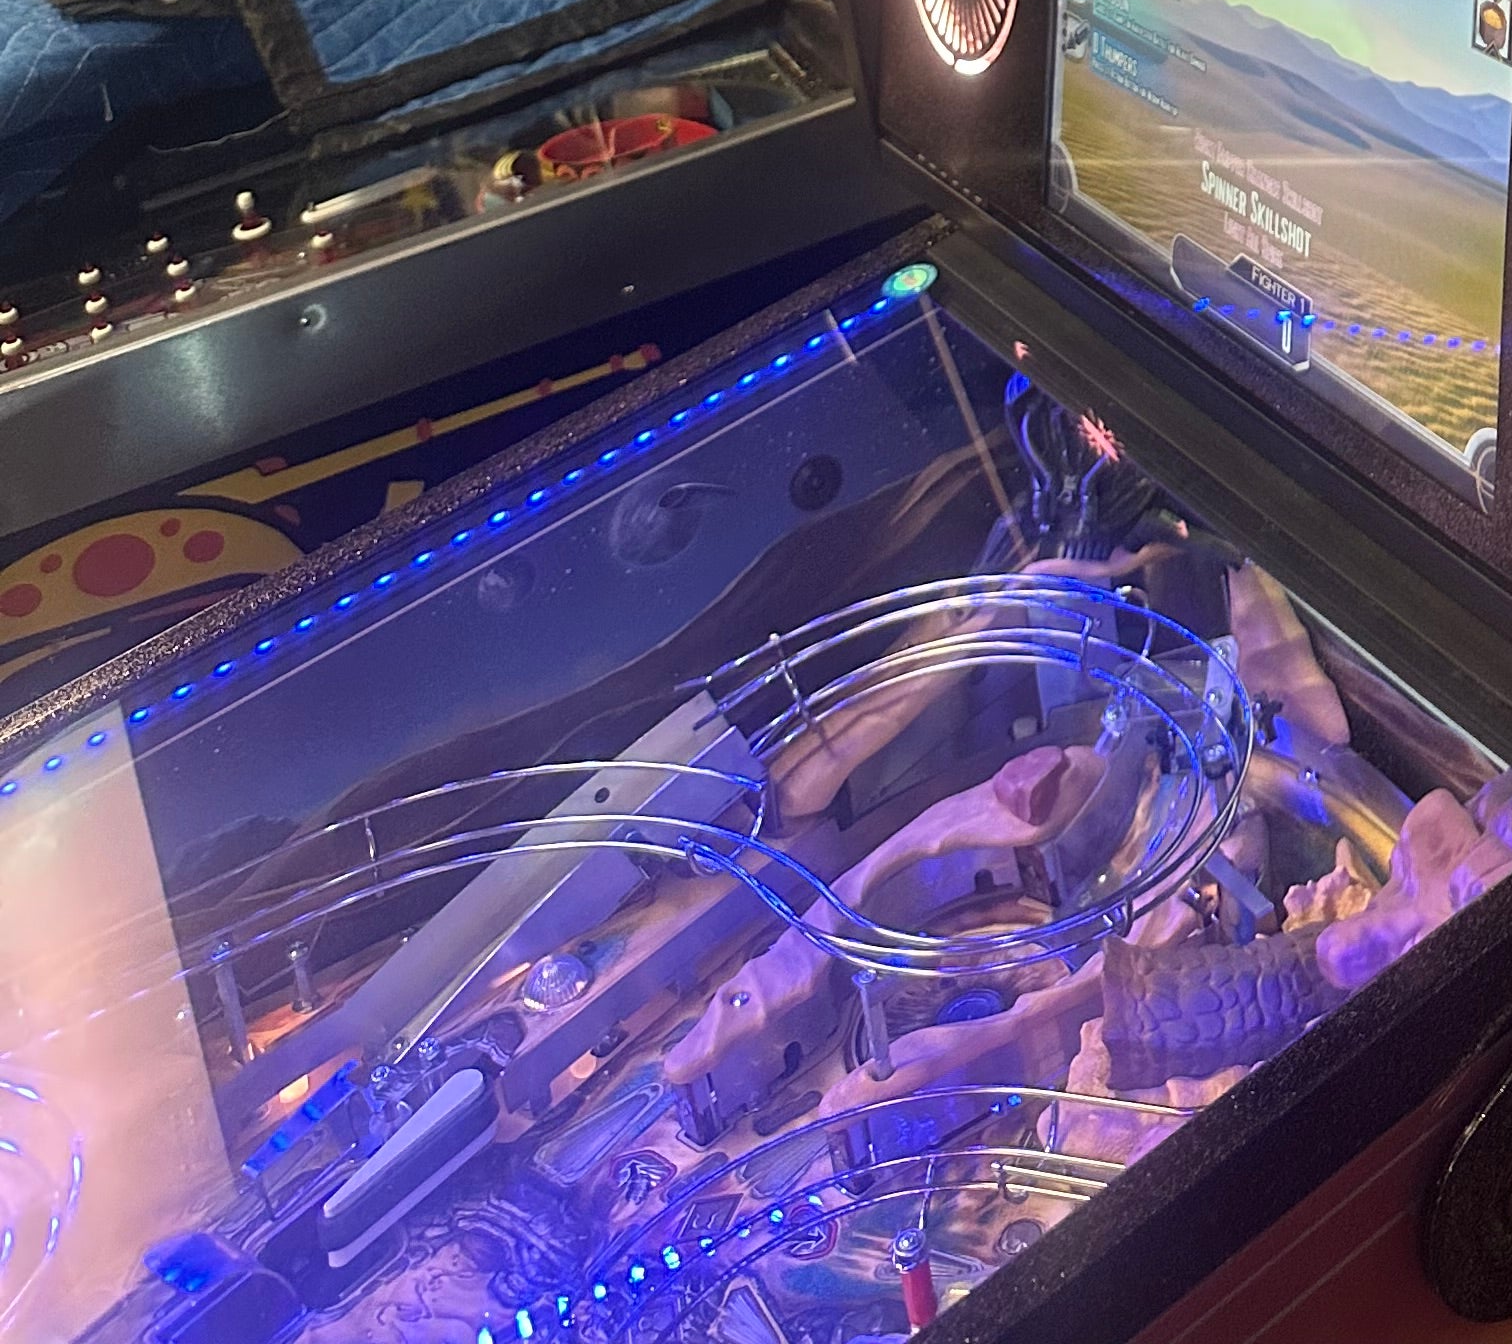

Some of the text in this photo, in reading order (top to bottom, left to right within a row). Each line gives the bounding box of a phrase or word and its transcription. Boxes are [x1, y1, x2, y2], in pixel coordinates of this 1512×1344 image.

[1200, 160, 1247, 217] SPINNER
[1250, 190, 1312, 259] SKILLSHOT
[1251, 265, 1296, 308] FIGHTER
